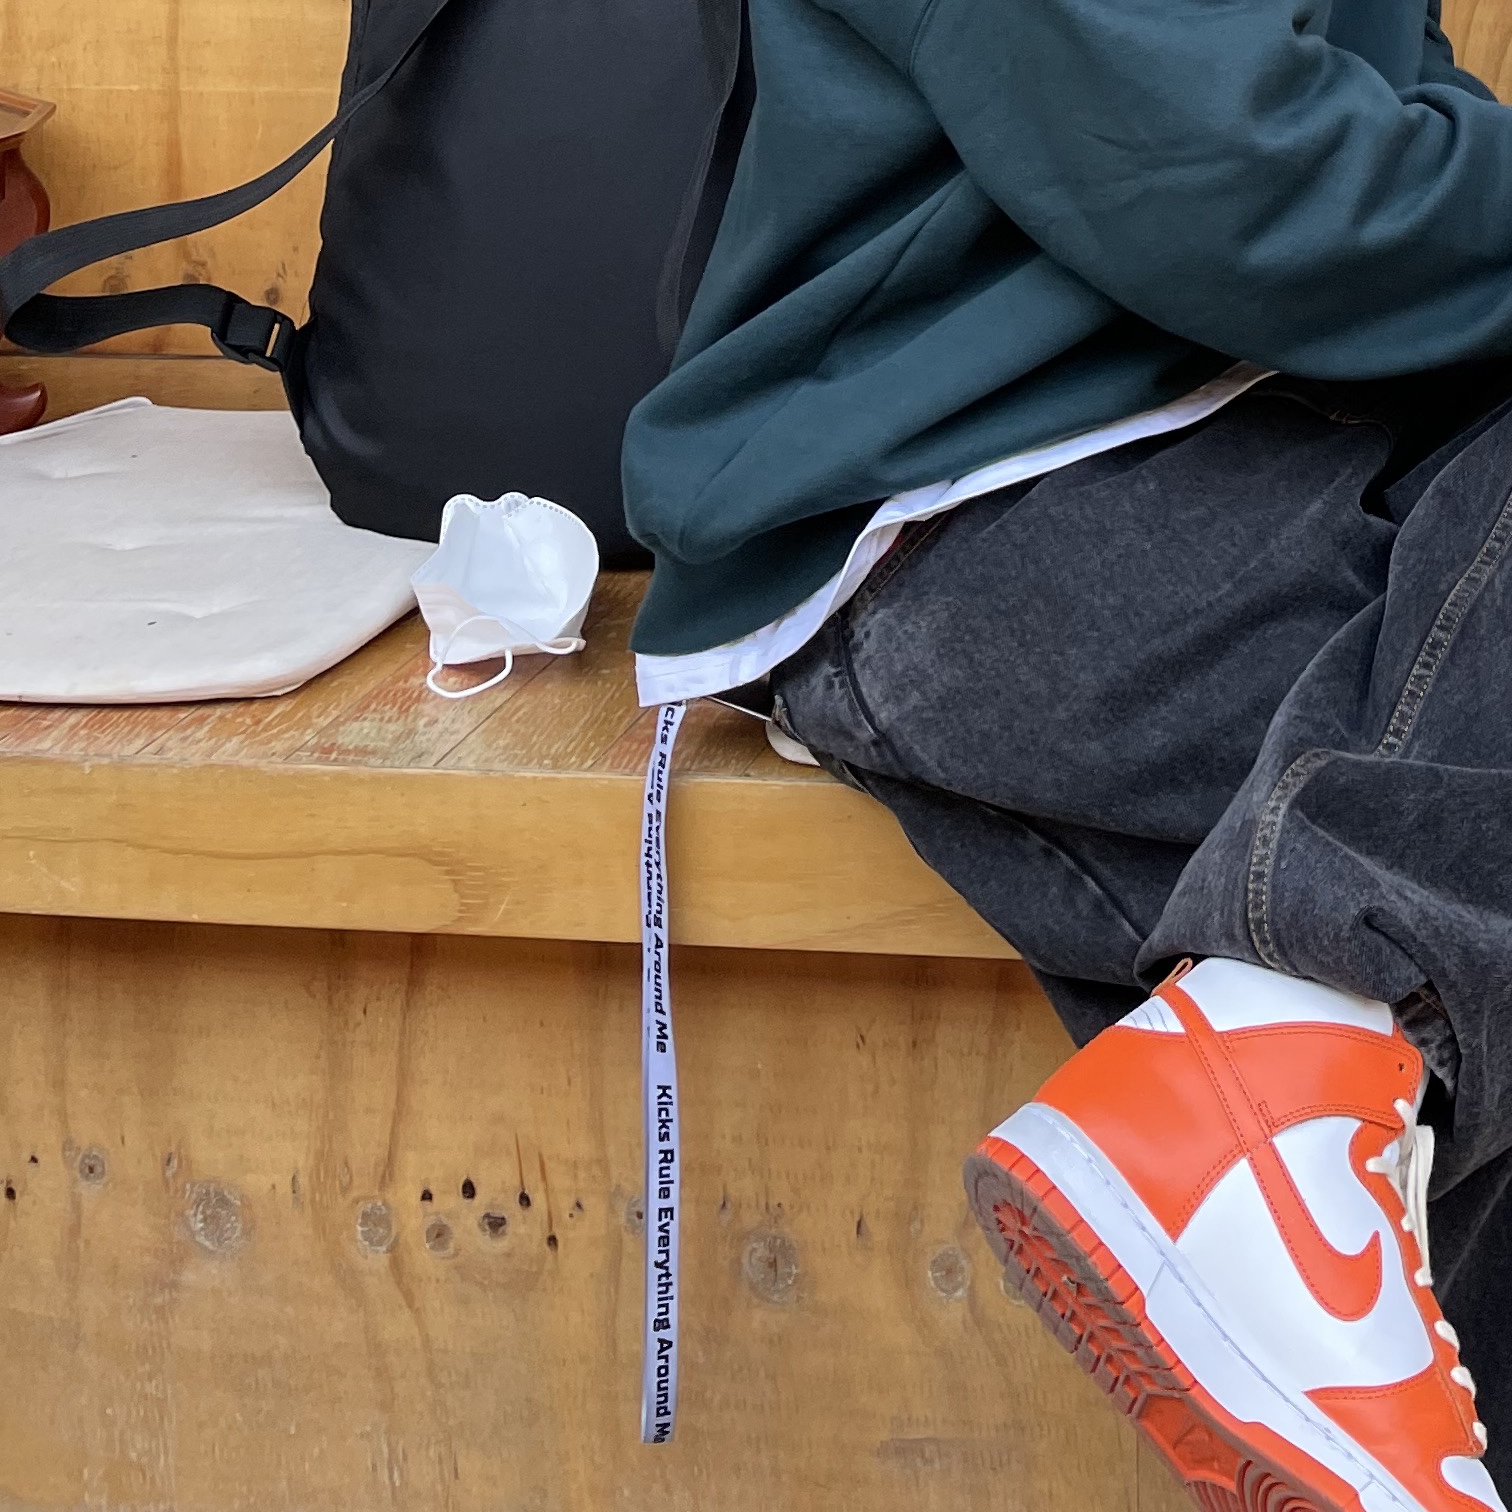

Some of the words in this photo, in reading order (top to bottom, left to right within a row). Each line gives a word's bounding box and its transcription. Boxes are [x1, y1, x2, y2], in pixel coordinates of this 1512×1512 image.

[657, 751, 667, 803] Rule
[653, 808, 665, 929] Everything
[654, 933, 667, 1016] Around
[656, 1020, 669, 1053] Me
[657, 1085, 673, 1142] Kicks
[658, 1149, 674, 1199] Rule
[653, 1207, 674, 1332] Everything
[655, 1338, 673, 1417] Around
